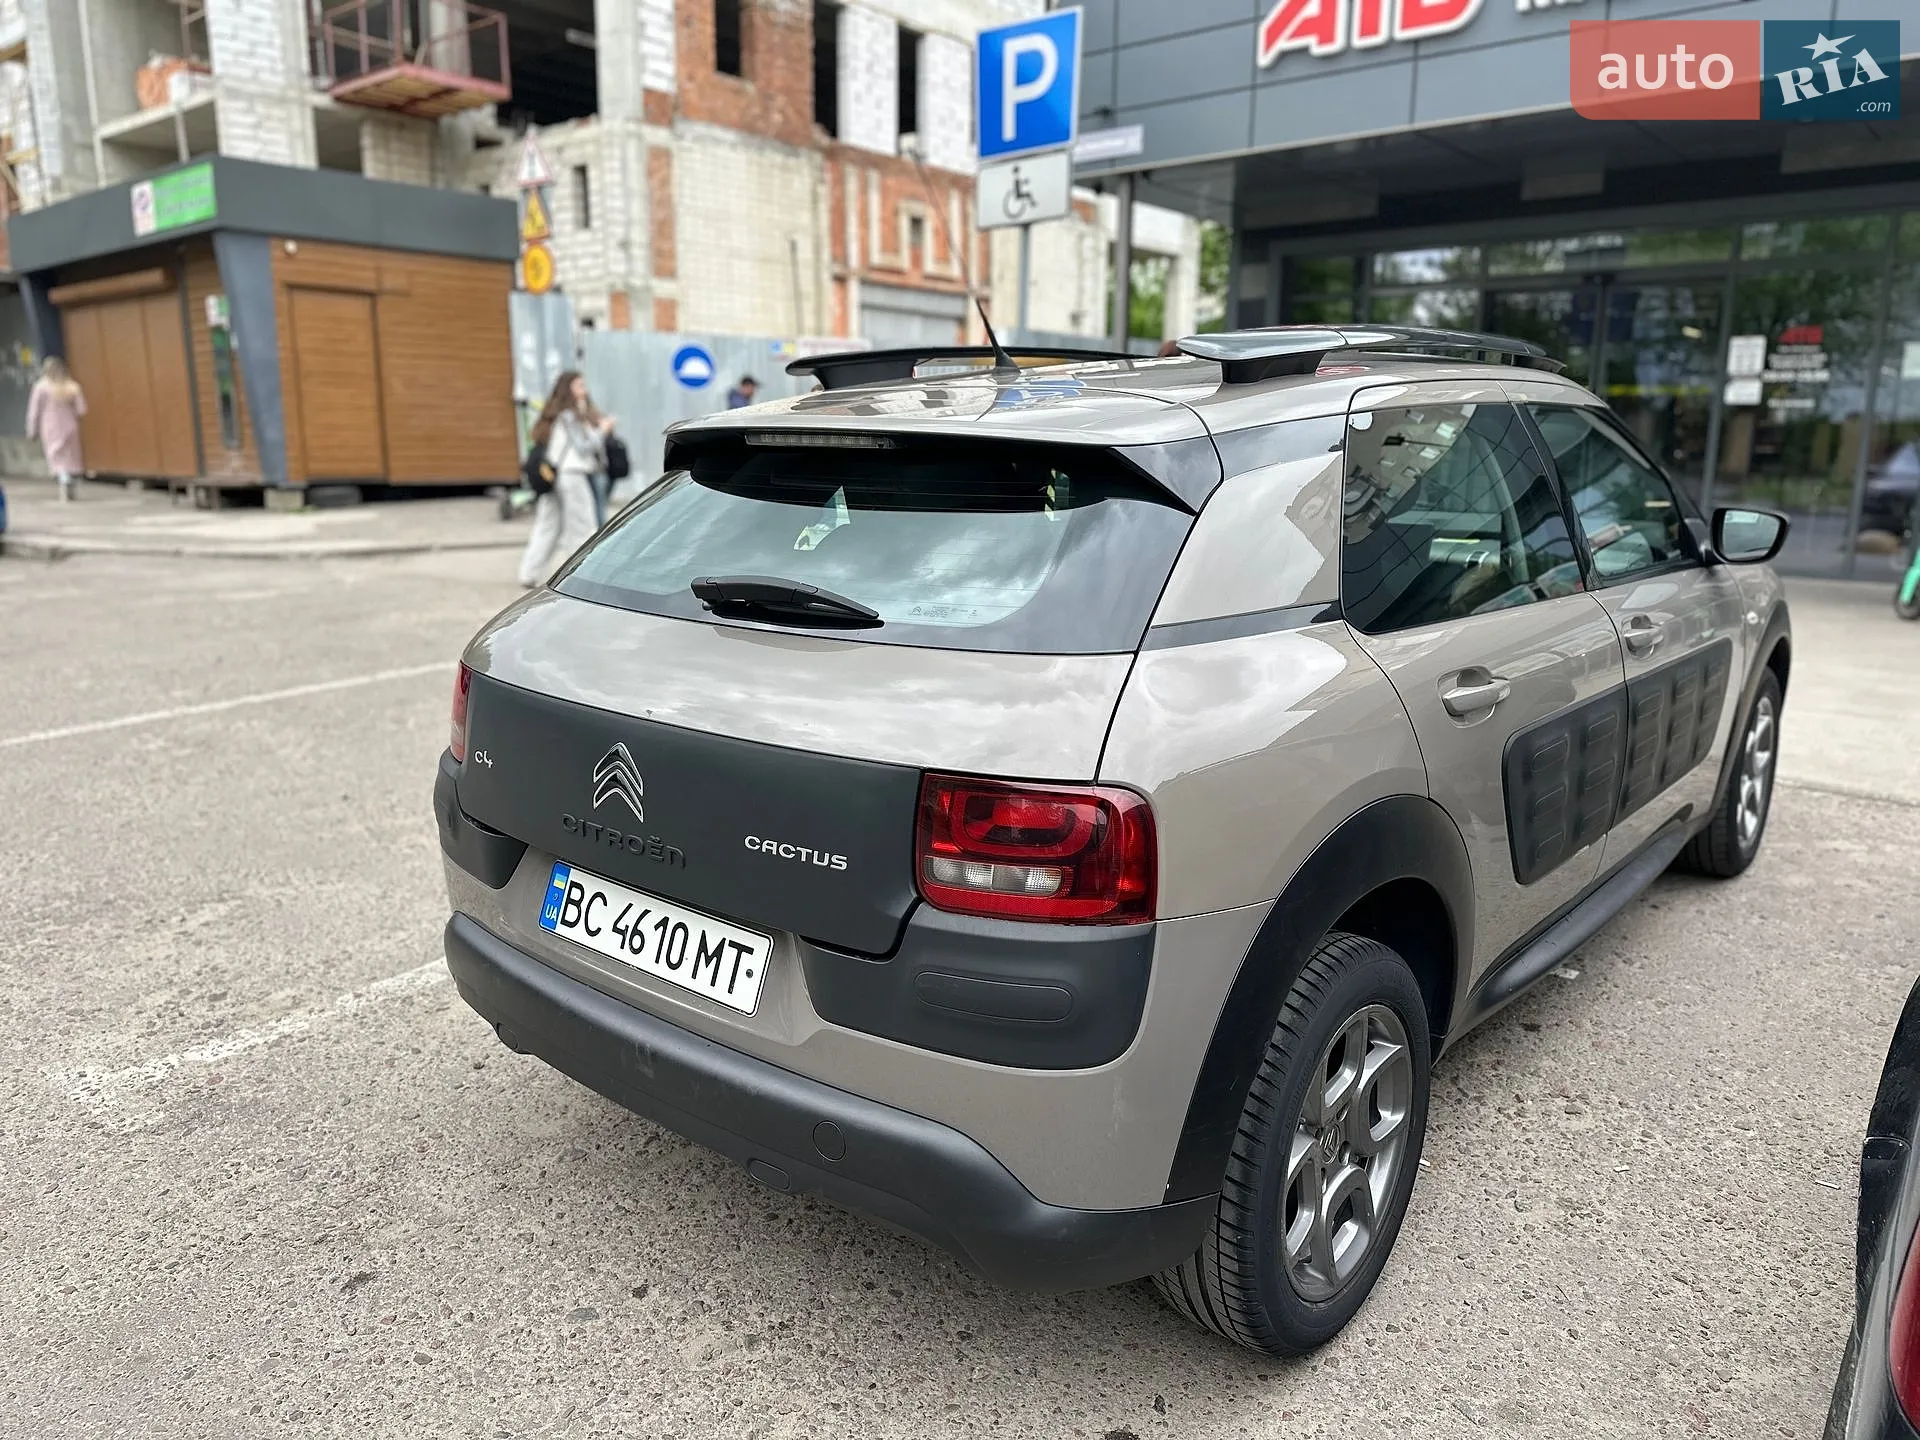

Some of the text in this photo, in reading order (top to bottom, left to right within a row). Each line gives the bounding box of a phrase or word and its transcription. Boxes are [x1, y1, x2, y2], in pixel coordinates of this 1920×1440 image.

[1002, 32, 1059, 143] P
[474, 750, 494, 769] C4
[744, 835, 848, 871] CACTUS
[545, 904, 558, 922] UA
[560, 880, 755, 995] BC 4610 MT
